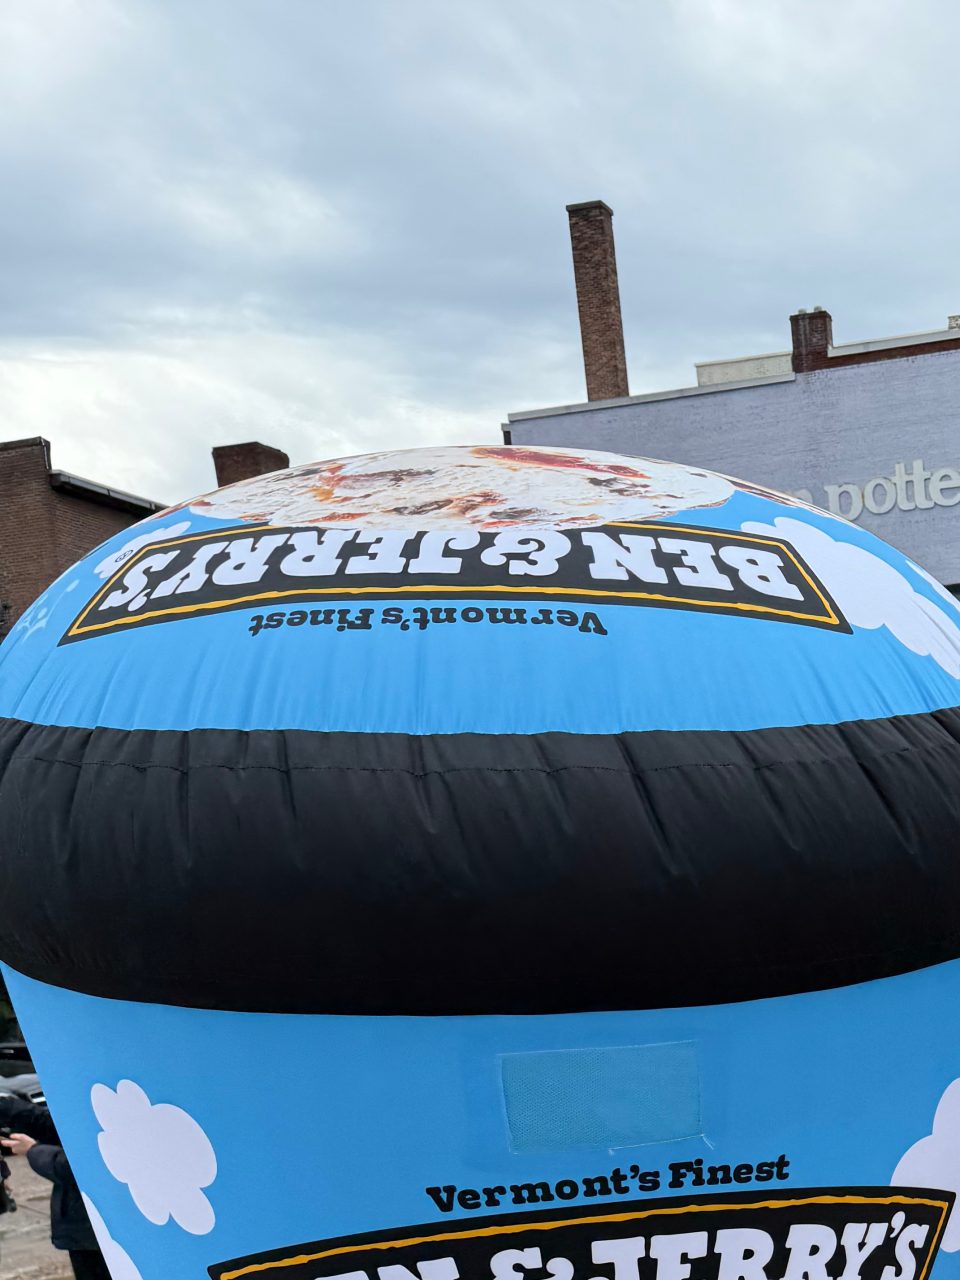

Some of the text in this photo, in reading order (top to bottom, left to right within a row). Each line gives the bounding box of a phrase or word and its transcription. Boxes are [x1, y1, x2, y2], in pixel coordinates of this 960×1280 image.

[97, 528, 805, 612] BEN & JERRY'S
[250, 606, 607, 635] Vermont's Finest
[425, 1154, 790, 1213] Vermont's Finest
